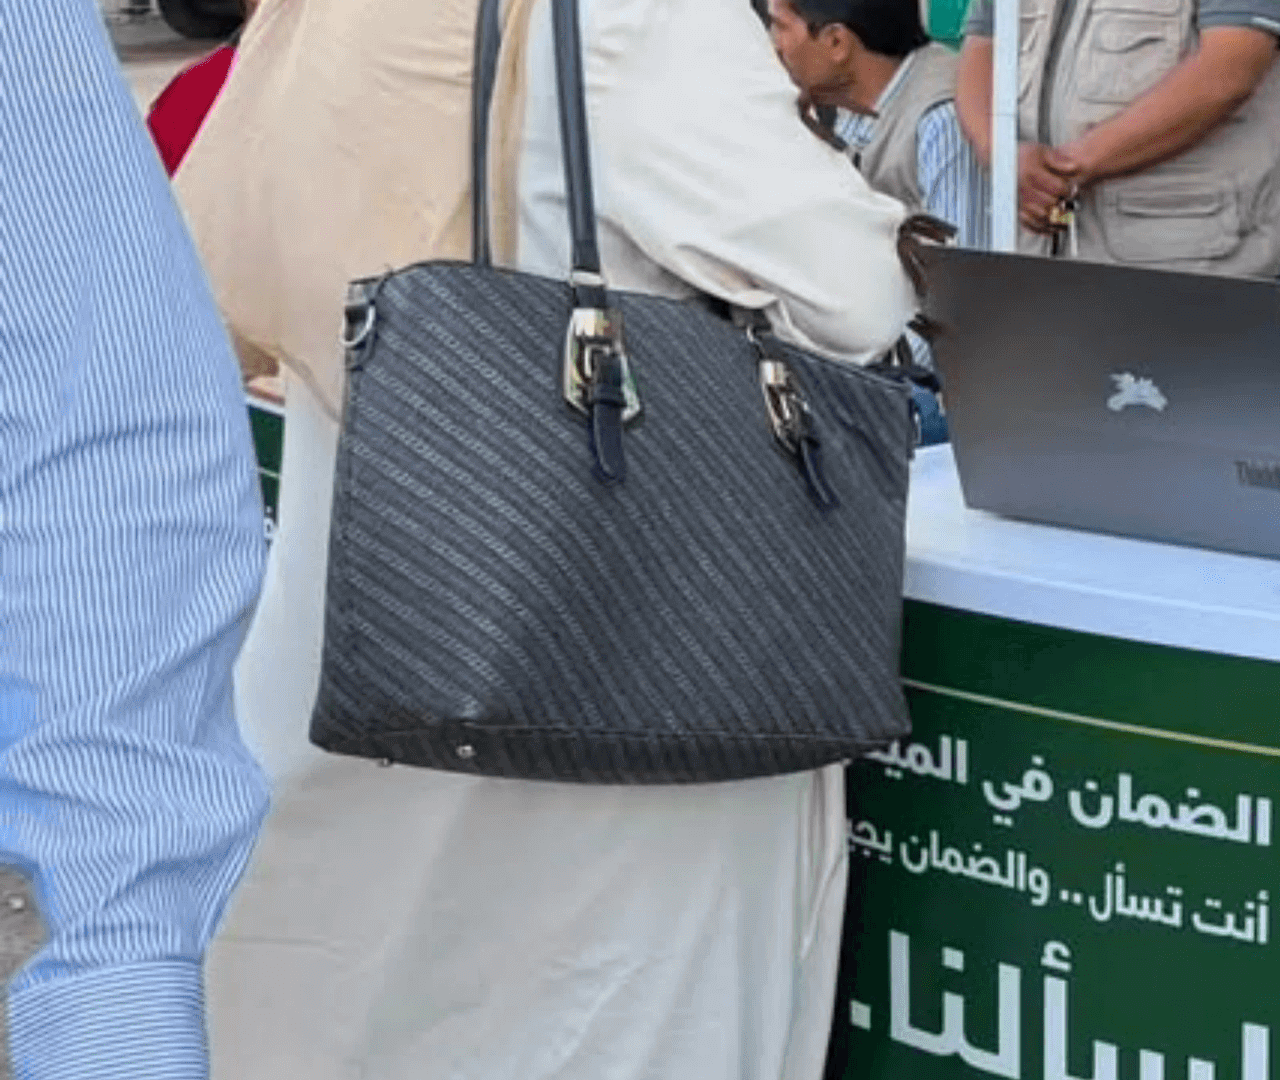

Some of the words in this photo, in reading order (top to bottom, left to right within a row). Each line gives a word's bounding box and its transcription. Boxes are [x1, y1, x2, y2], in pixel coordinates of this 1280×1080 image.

[867, 734, 968, 785] المي
[982, 754, 1054, 827] في
[848, 818, 893, 865] يجي
[1067, 772, 1272, 847] الضمان
[900, 830, 1051, 907] والضمان
[1191, 889, 1269, 944] أنت
